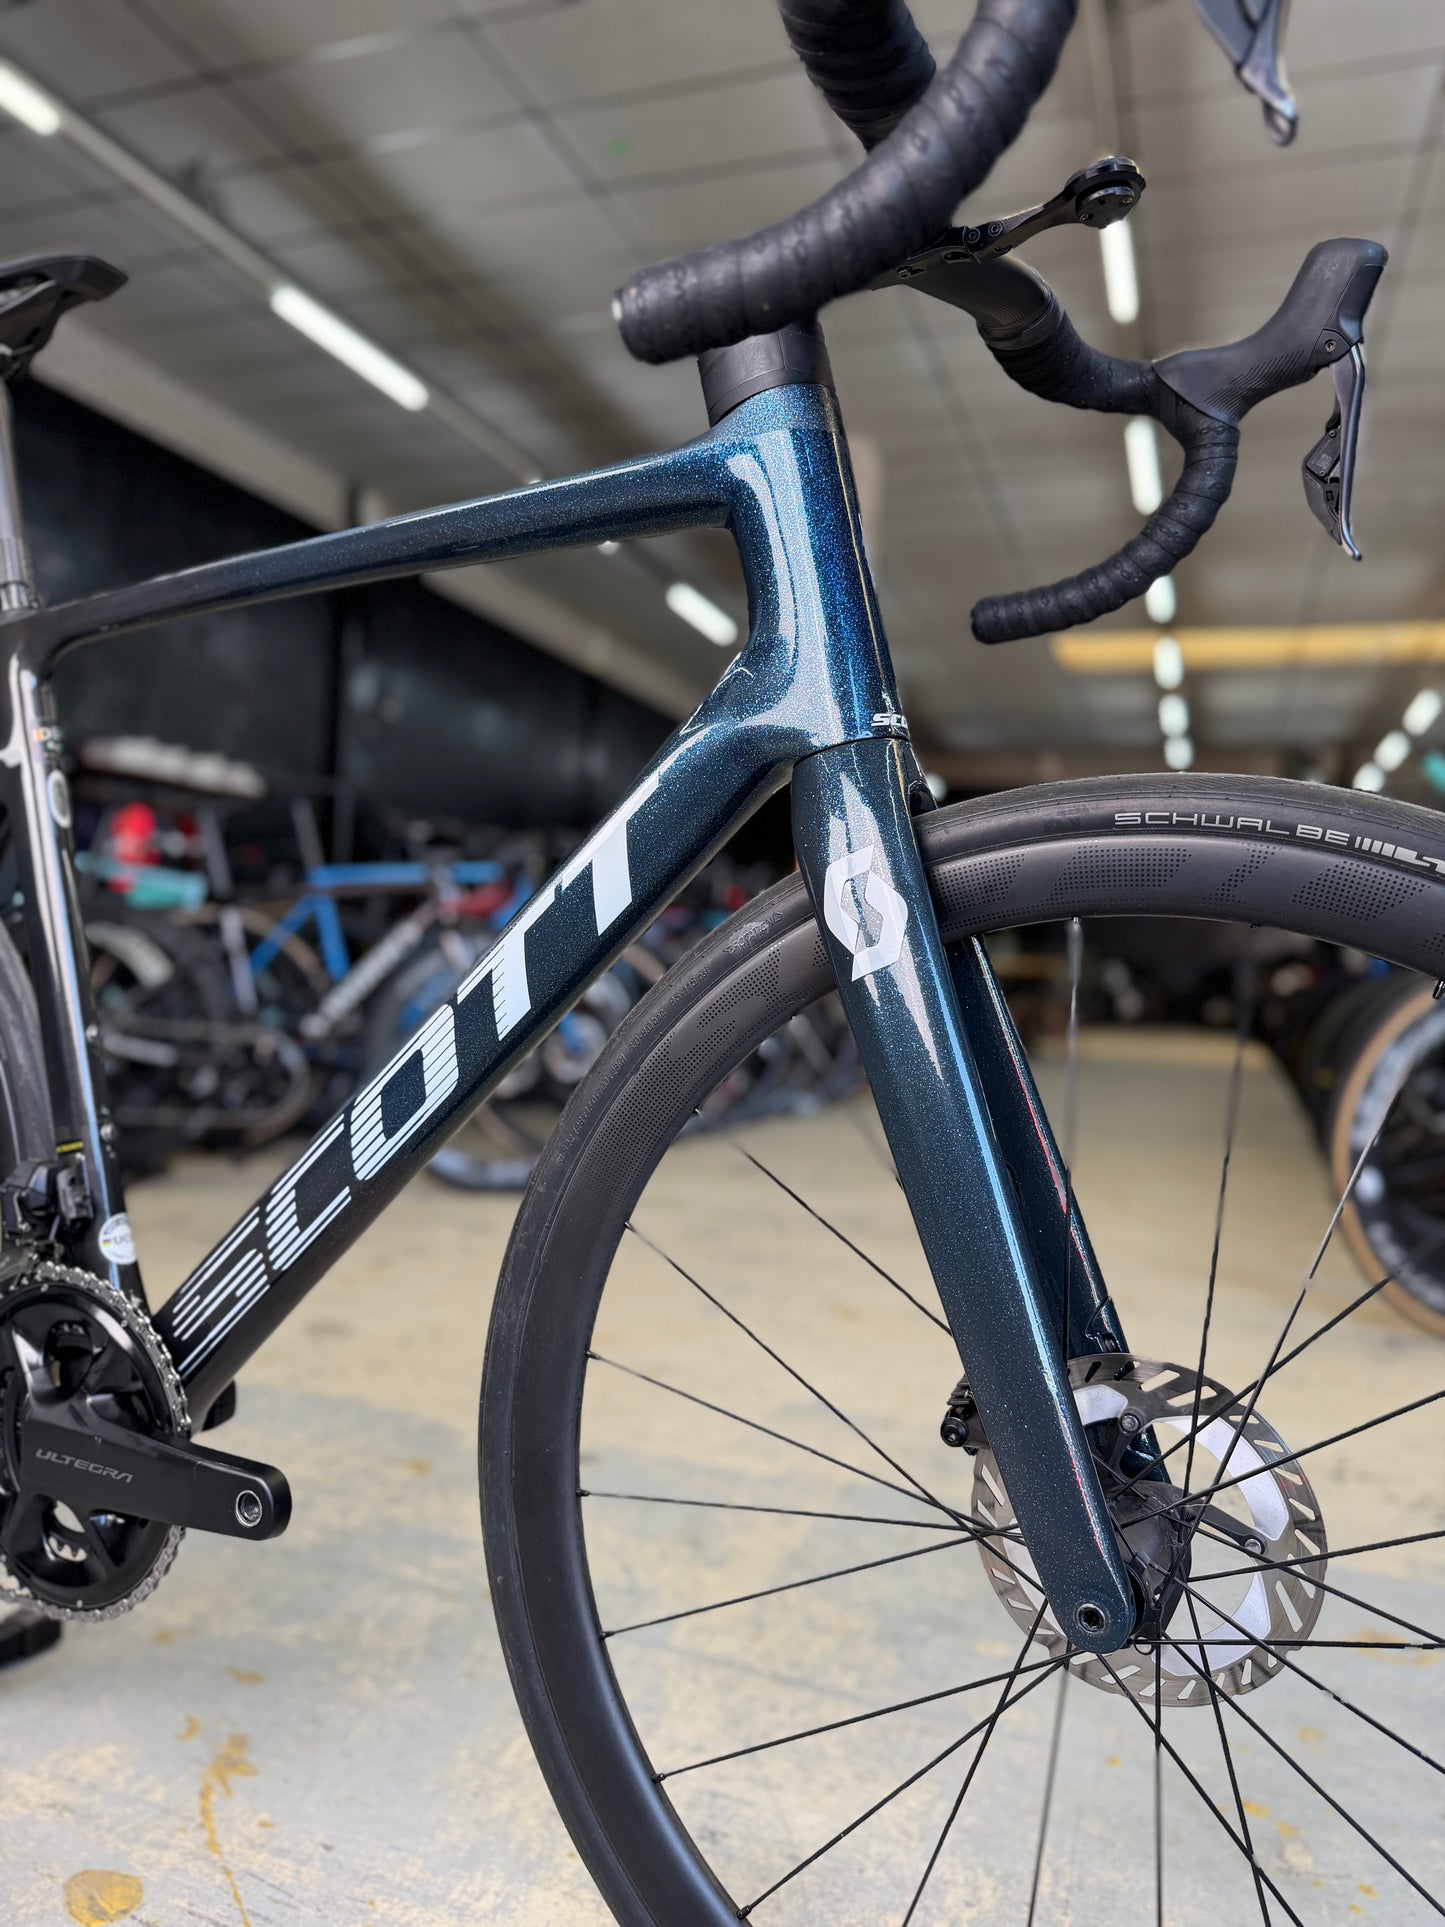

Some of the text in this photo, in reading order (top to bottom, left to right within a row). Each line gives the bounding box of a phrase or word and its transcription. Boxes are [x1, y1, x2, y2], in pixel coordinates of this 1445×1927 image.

[1114, 812, 1350, 846] SCHWALBE
[172, 767, 660, 1379] SCOTT
[35, 1448, 133, 1483] ULTEGRA
